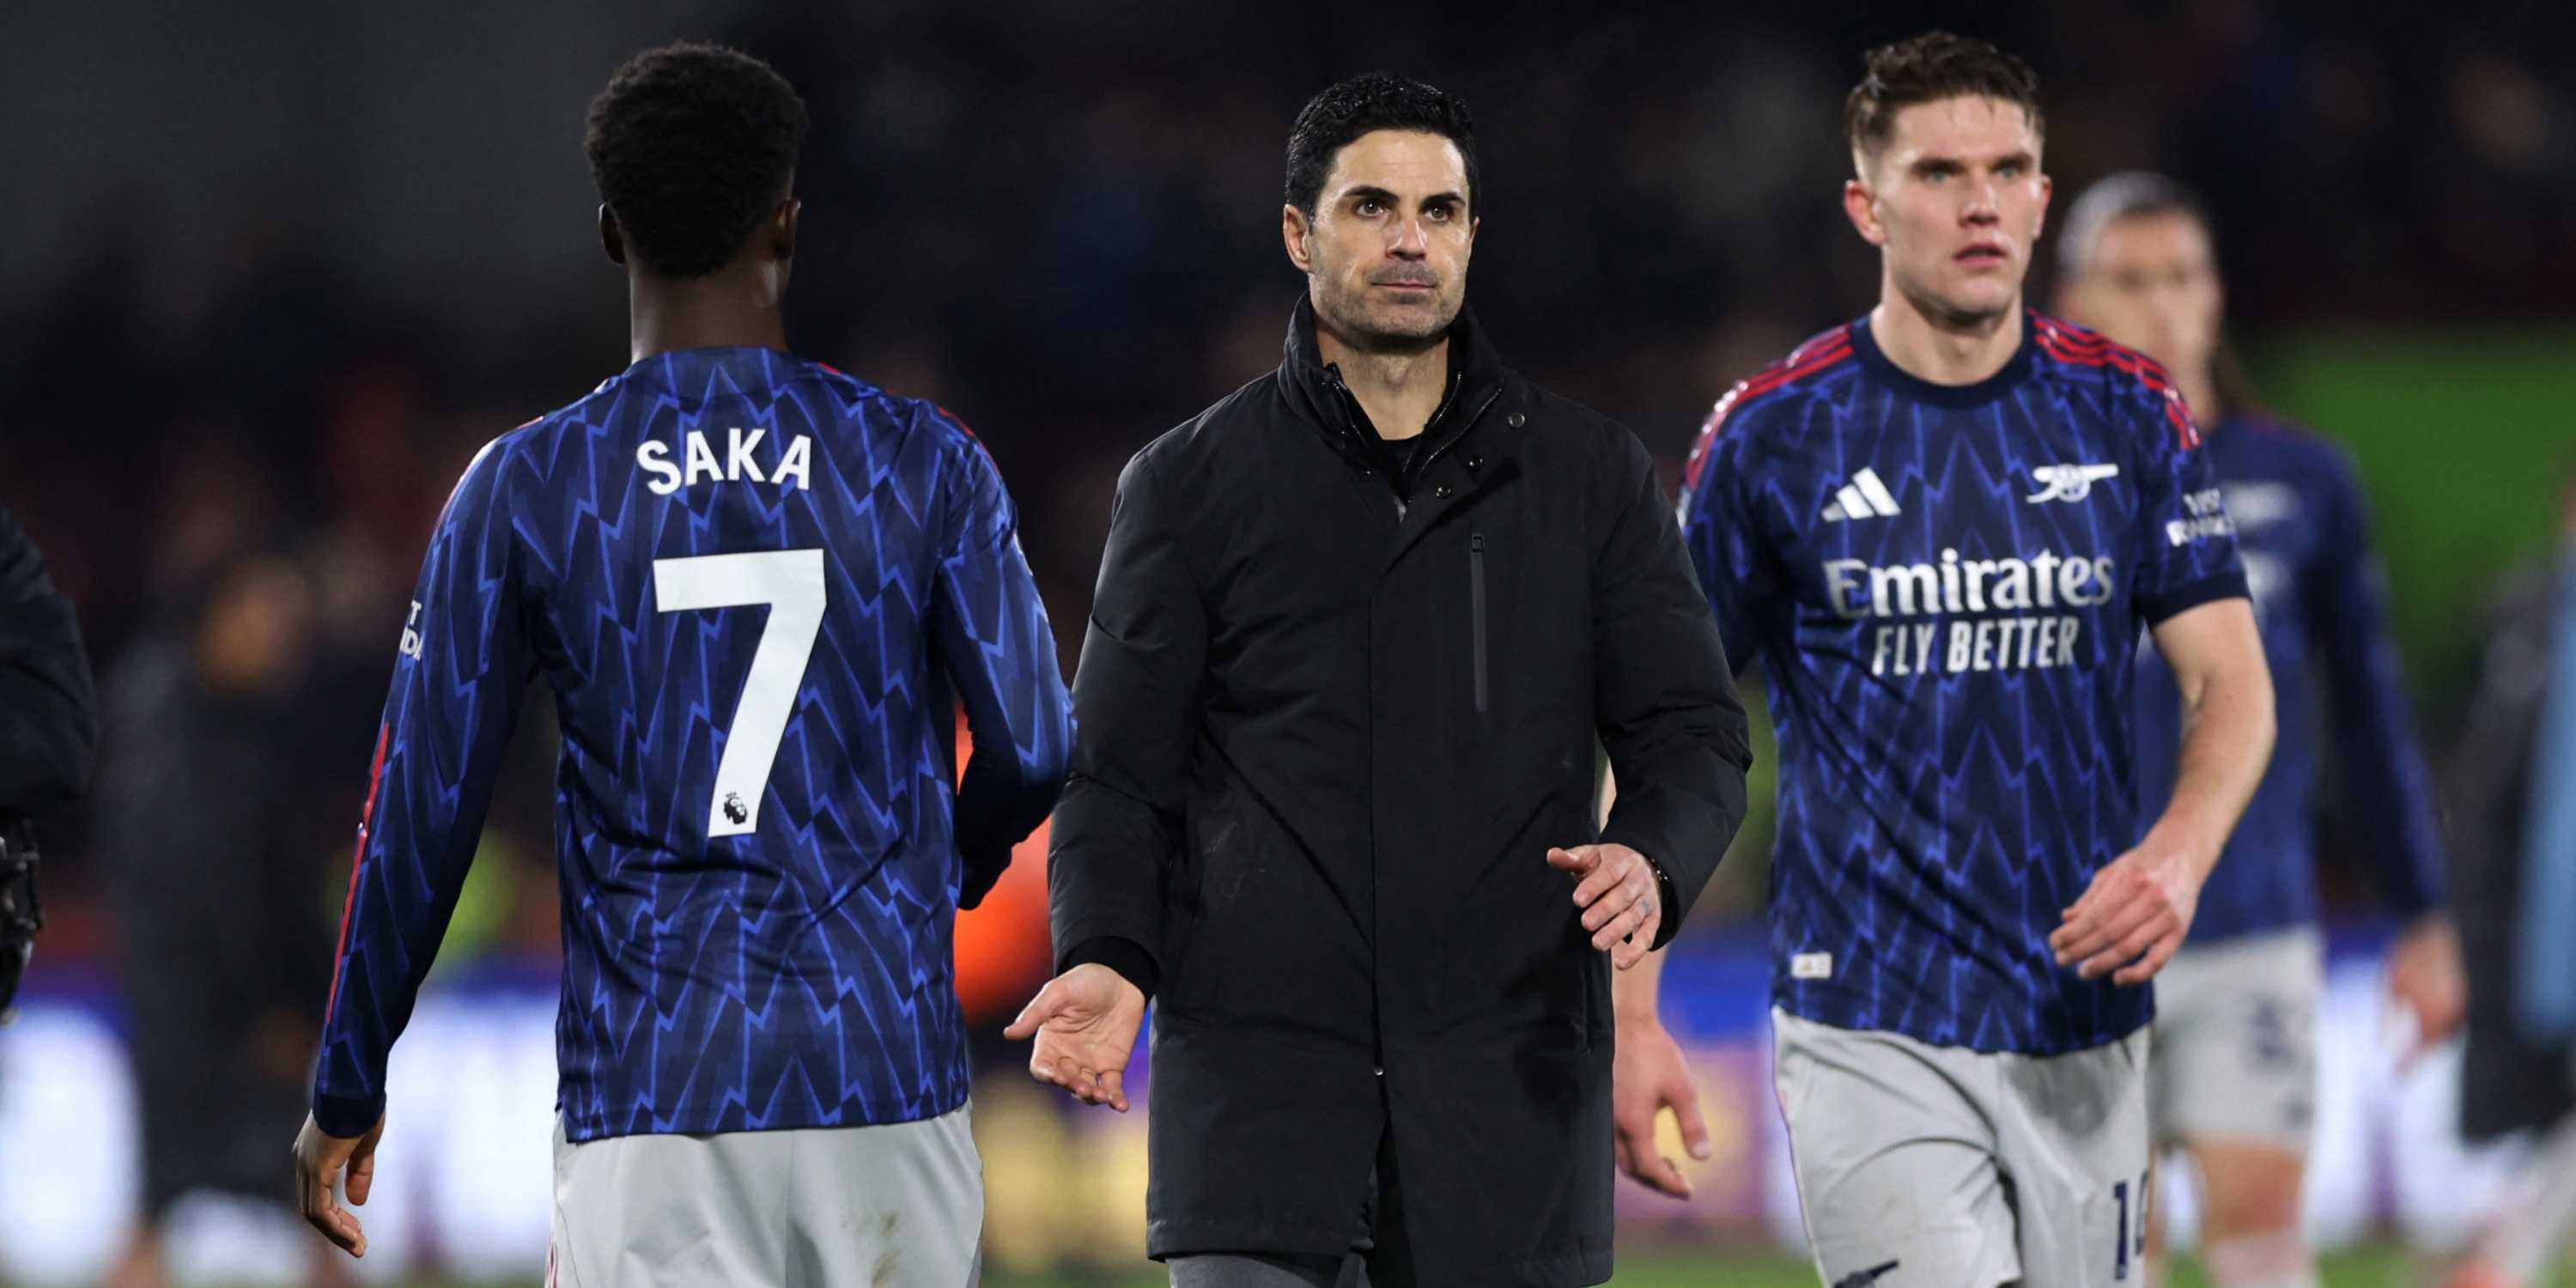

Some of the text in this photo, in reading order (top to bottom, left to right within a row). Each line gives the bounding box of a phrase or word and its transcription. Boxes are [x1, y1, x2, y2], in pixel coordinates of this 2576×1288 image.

[636, 428, 811, 495] SAKA
[1823, 548, 2115, 619] Emirates
[1872, 616, 2081, 677] FLY BETTER
[653, 548, 827, 838] 7
